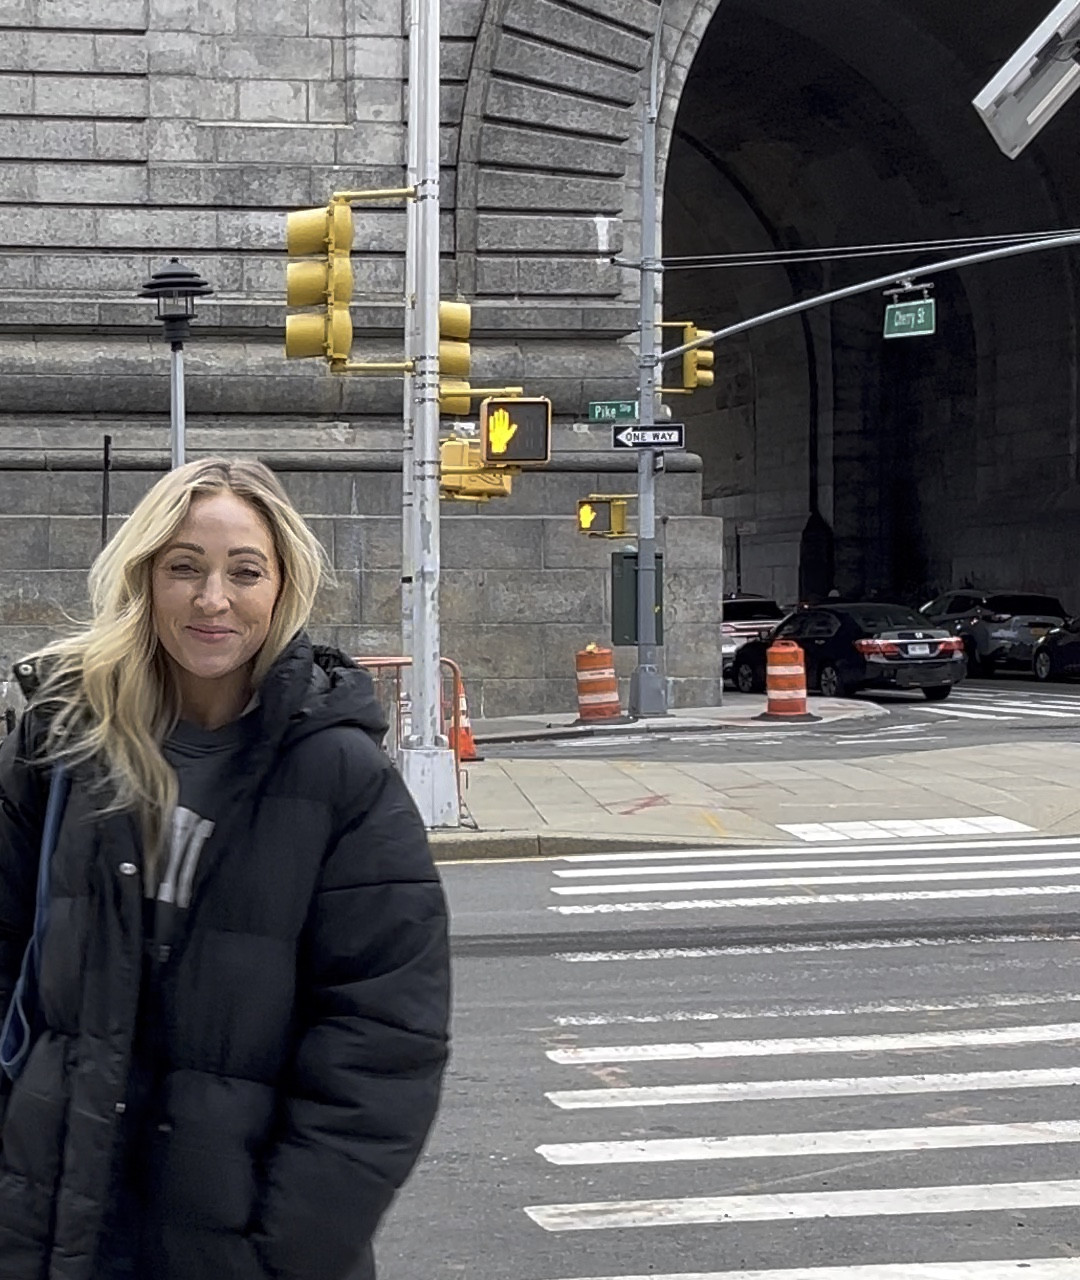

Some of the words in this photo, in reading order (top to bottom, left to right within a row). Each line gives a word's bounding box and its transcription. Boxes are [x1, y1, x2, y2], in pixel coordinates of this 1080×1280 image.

[595, 405, 617, 419] Pike
[625, 432, 647, 442] ONE
[653, 432, 675, 441] WAY
